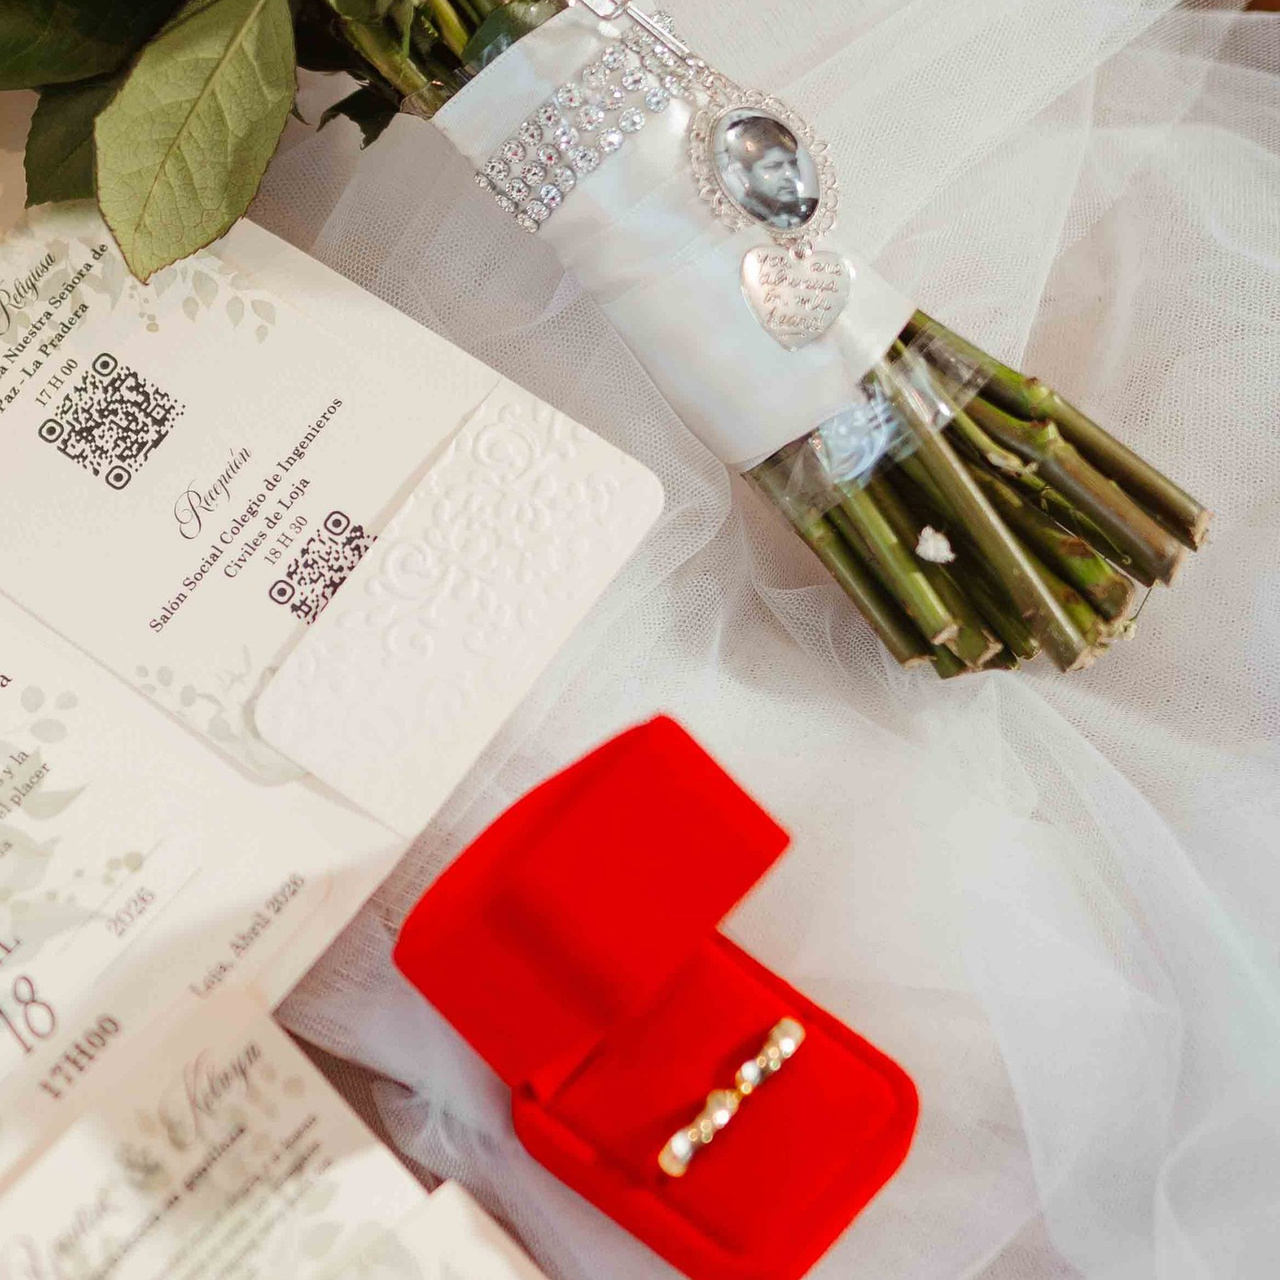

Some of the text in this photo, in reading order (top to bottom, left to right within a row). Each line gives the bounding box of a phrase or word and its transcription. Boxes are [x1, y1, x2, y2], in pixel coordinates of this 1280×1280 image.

[760, 268, 835, 294] always
[810, 260, 843, 276] are
[2, 310, 54, 364] Nuestra
[48, 262, 94, 310] Señora
[90, 244, 109, 262] de
[21, 358, 44, 378] La
[38, 302, 90, 358] Pradera
[34, 358, 79, 408] 17 H 00
[148, 398, 344, 634] Salón Social Colegio de Ingenieros
[172, 446, 252, 540] Recepción
[222, 478, 312, 578] Civiles de Loja
[262, 514, 308, 566] 18 H 30
[2, 764, 14, 778] y
[9, 750, 29, 766] la
[8, 762, 52, 806] placer
[104, 884, 156, 939] 2026
[264, 872, 306, 916] 2026
[38, 1016, 120, 1100] 17H00
